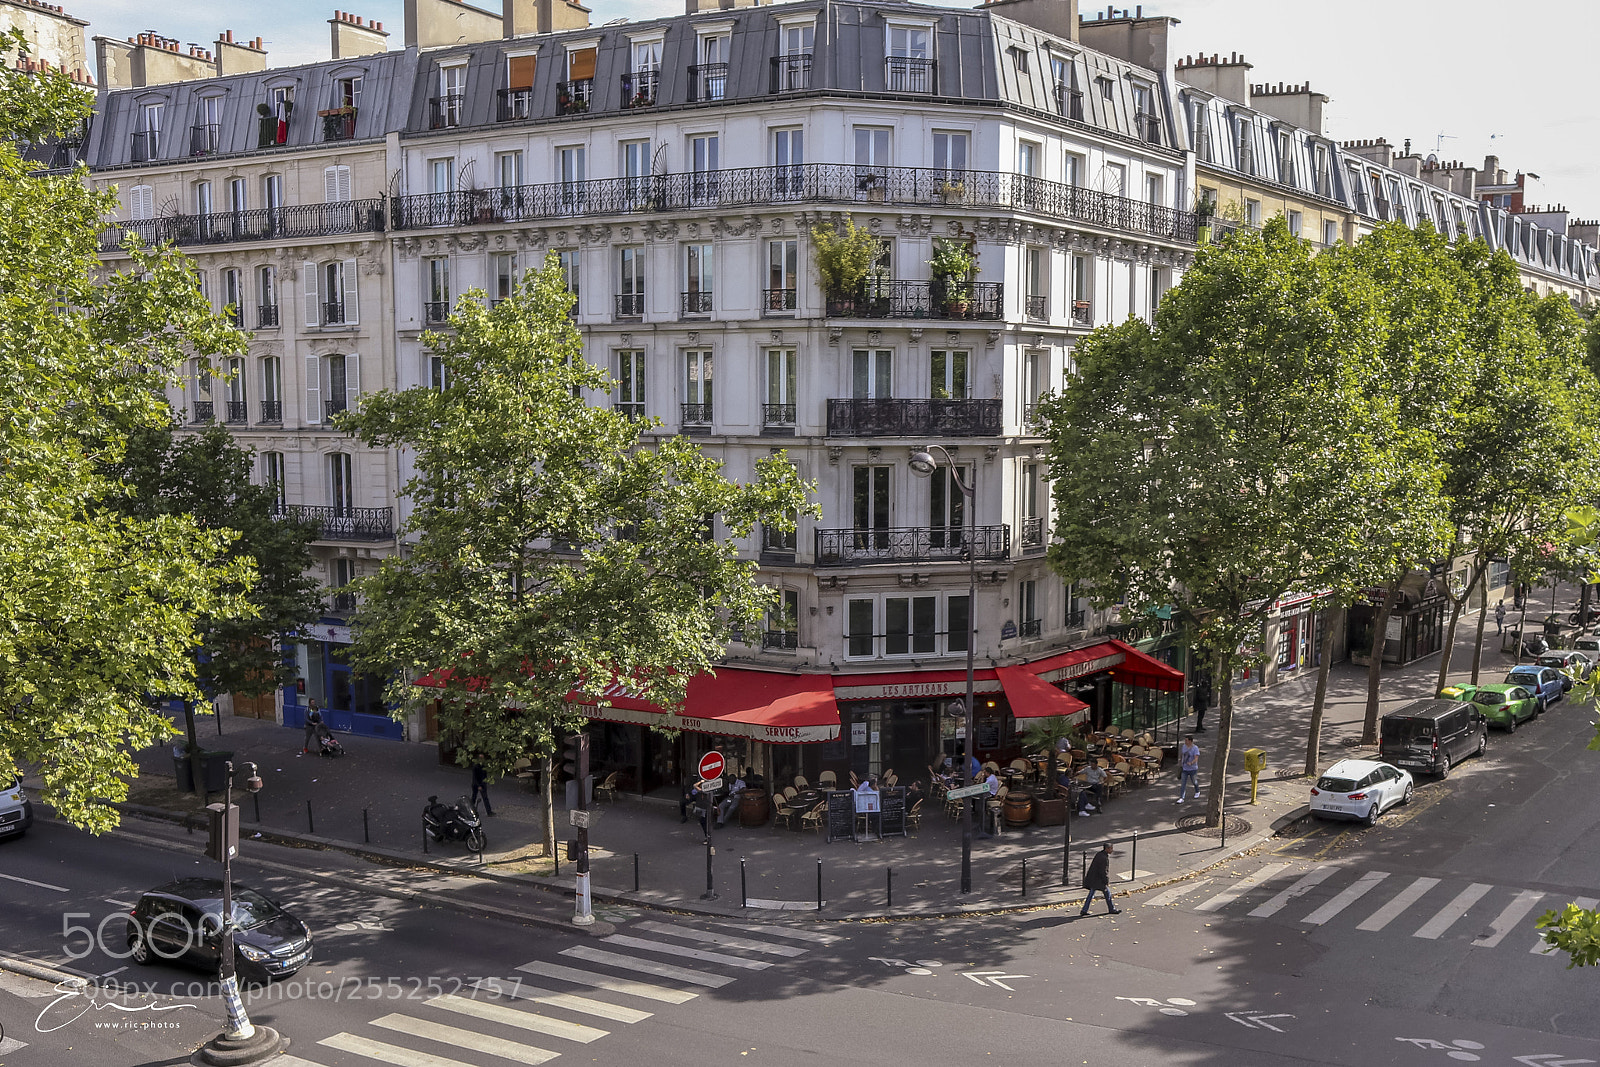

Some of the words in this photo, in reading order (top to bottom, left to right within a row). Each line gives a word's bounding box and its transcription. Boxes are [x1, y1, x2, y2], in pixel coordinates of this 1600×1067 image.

[882, 686, 899, 696] LES
[902, 683, 949, 695] ARTISANS
[682, 718, 701, 728] RESTO
[765, 727, 800, 737] SERVICE
